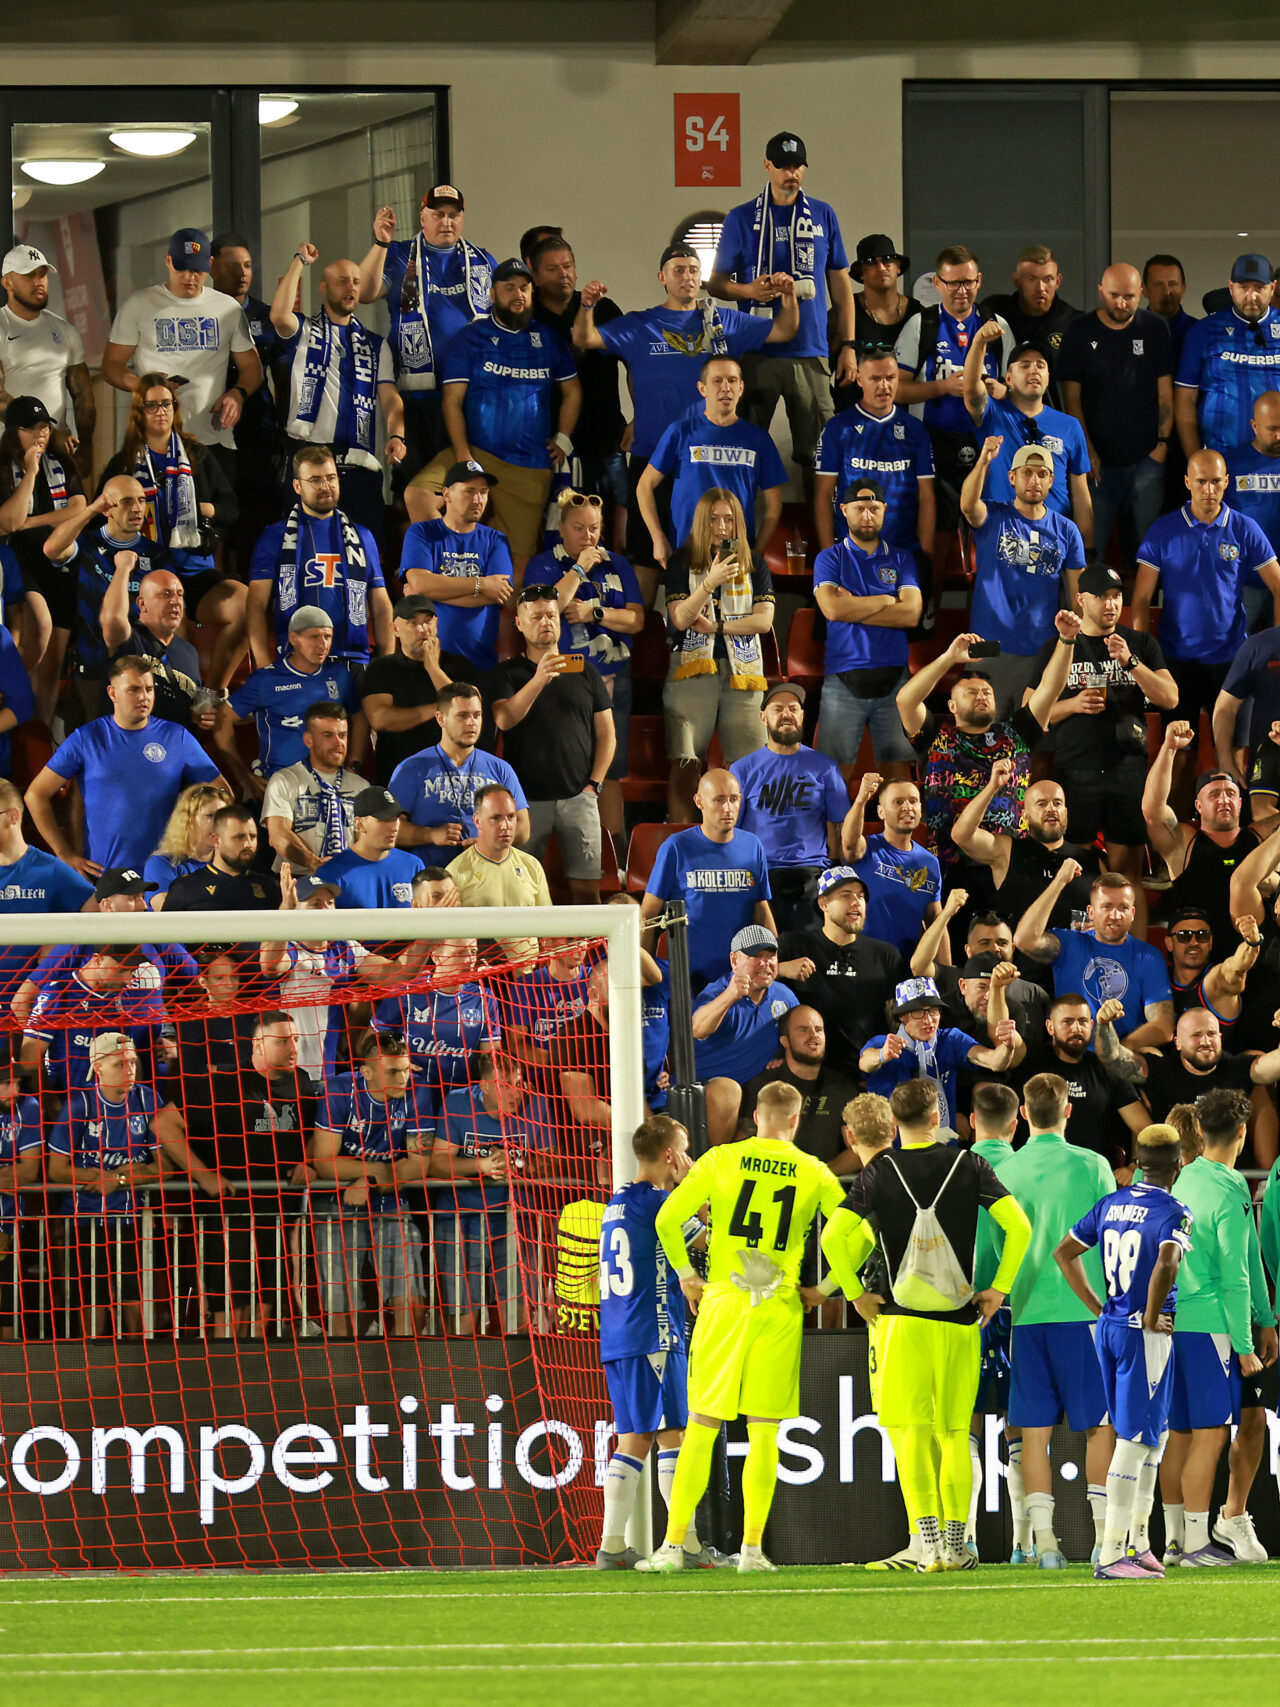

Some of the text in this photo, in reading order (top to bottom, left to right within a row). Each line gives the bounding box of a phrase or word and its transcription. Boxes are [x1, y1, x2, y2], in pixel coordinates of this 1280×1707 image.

[685, 115, 729, 151] S4
[156, 317, 219, 347] 061
[483, 361, 549, 379] SUPERBET
[713, 452, 754, 466] DWL
[851, 457, 911, 472] SUPERBET
[275, 683, 302, 692] macron
[757, 777, 816, 816] NIKE
[697, 871, 747, 888] KOLEJORZ
[412, 1037, 471, 1058] Ultras
[741, 1155, 798, 1178] MROZEK
[728, 1178, 797, 1252] 41
